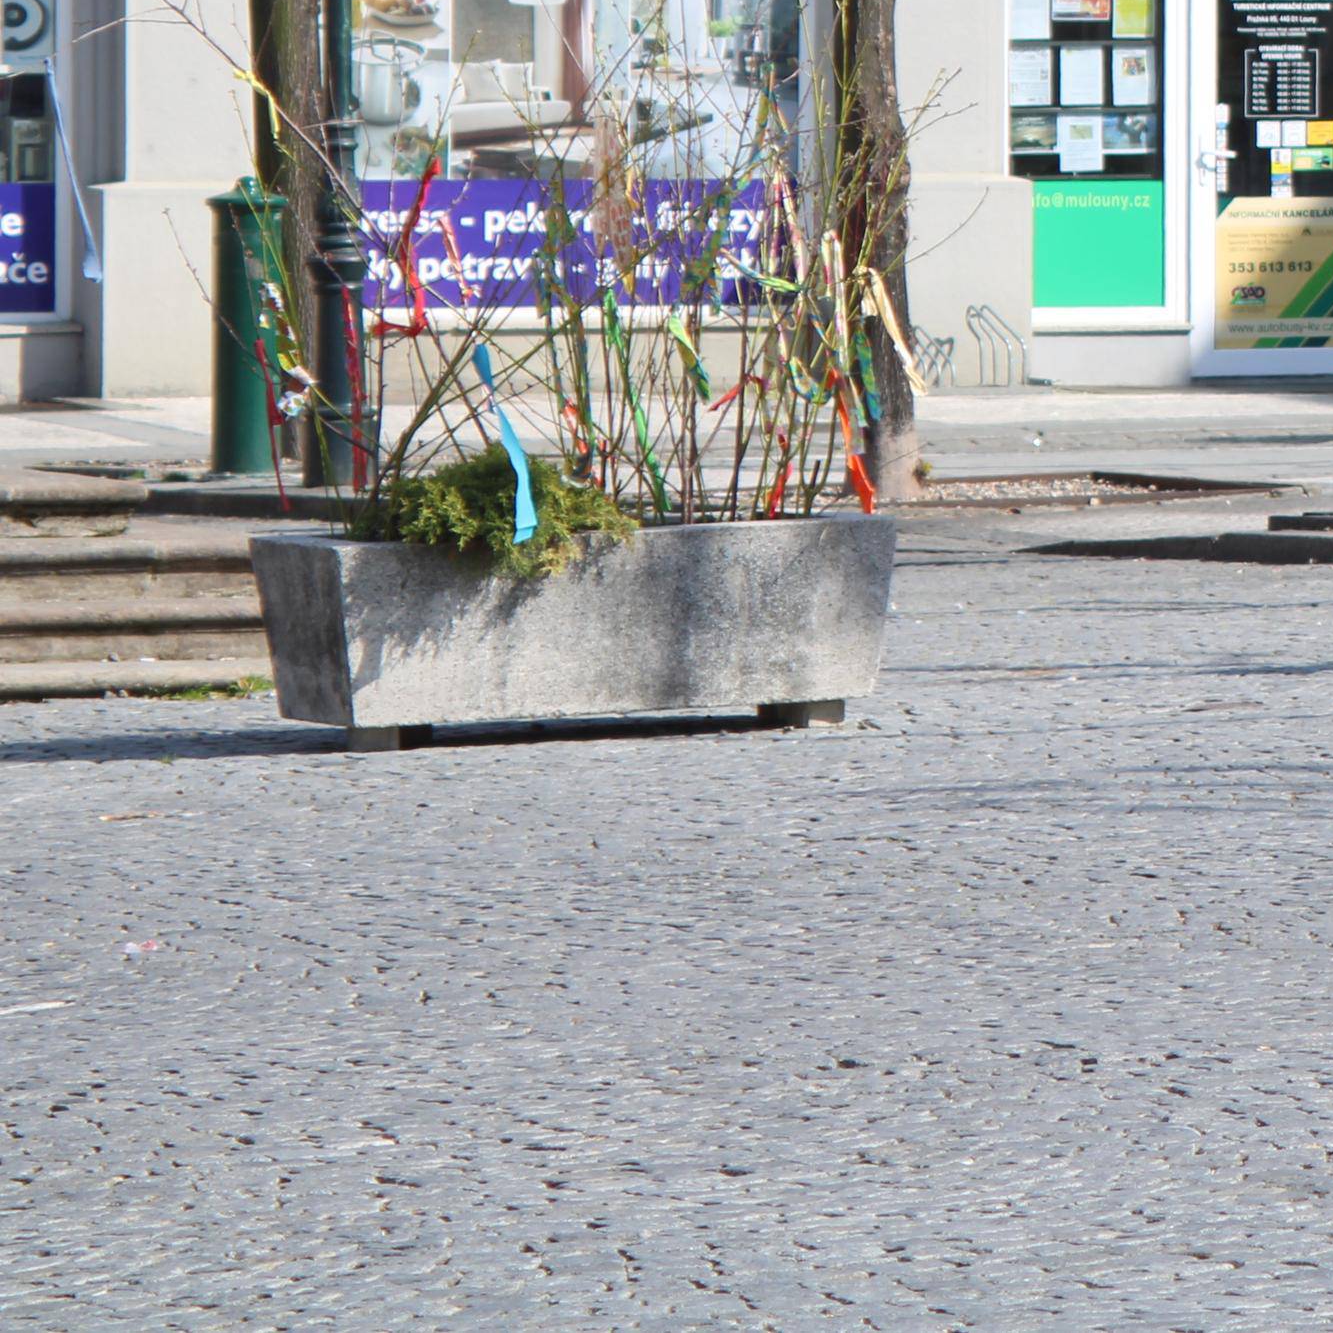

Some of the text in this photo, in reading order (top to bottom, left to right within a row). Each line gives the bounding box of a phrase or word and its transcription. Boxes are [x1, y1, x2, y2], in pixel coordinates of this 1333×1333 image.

[1031, 192, 1151, 211] fo@mulouny.cz
[1228, 260, 1312, 273] 353 613 613
